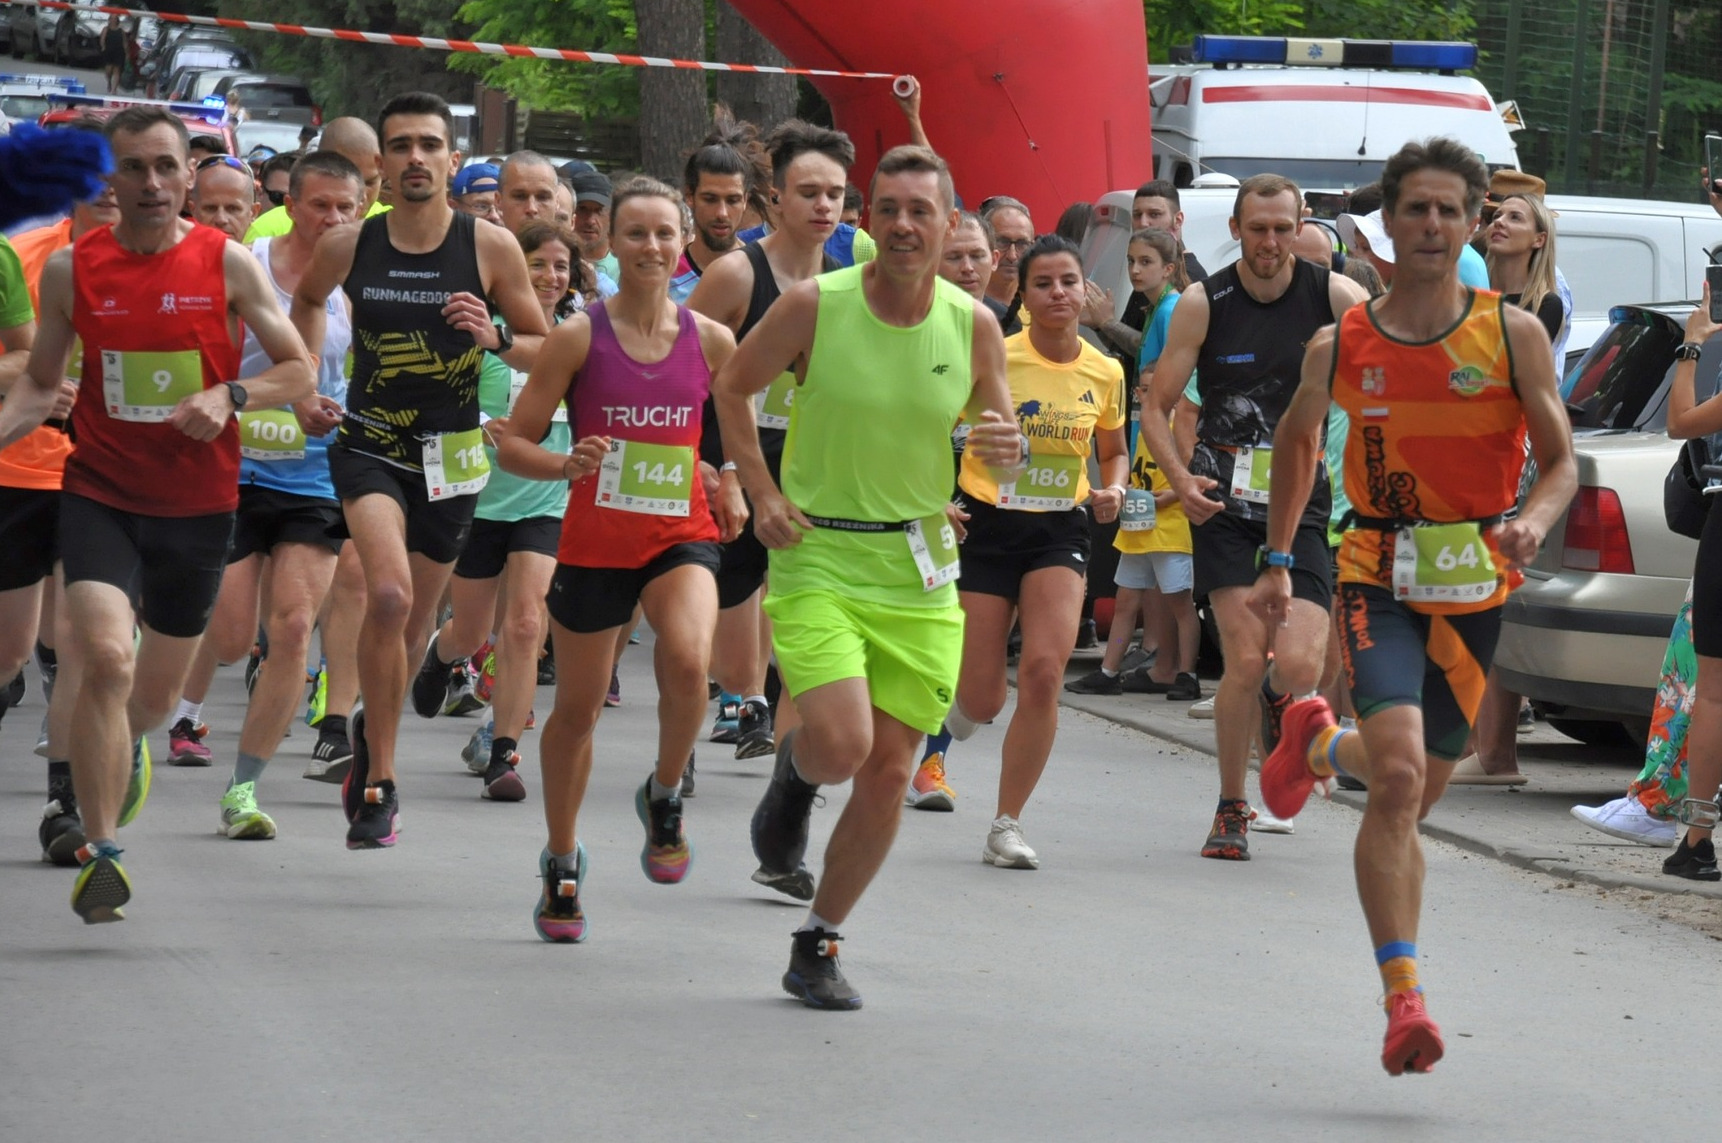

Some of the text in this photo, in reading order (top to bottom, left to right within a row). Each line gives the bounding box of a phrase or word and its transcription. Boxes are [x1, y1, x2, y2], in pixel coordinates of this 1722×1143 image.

[388, 265, 440, 279] SMMASH
[362, 287, 453, 304] RUNMAGEDDO
[932, 365, 949, 375] 4F
[152, 370, 172, 392] 9
[601, 406, 693, 428] TRUCHT
[248, 419, 297, 444] 100
[1027, 423, 1090, 441] WORLD RUN
[454, 445, 484, 469] 115
[633, 461, 683, 486] 144
[1027, 467, 1069, 488] 186
[1121, 499, 1148, 514] 55
[1436, 543, 1478, 572] 64
